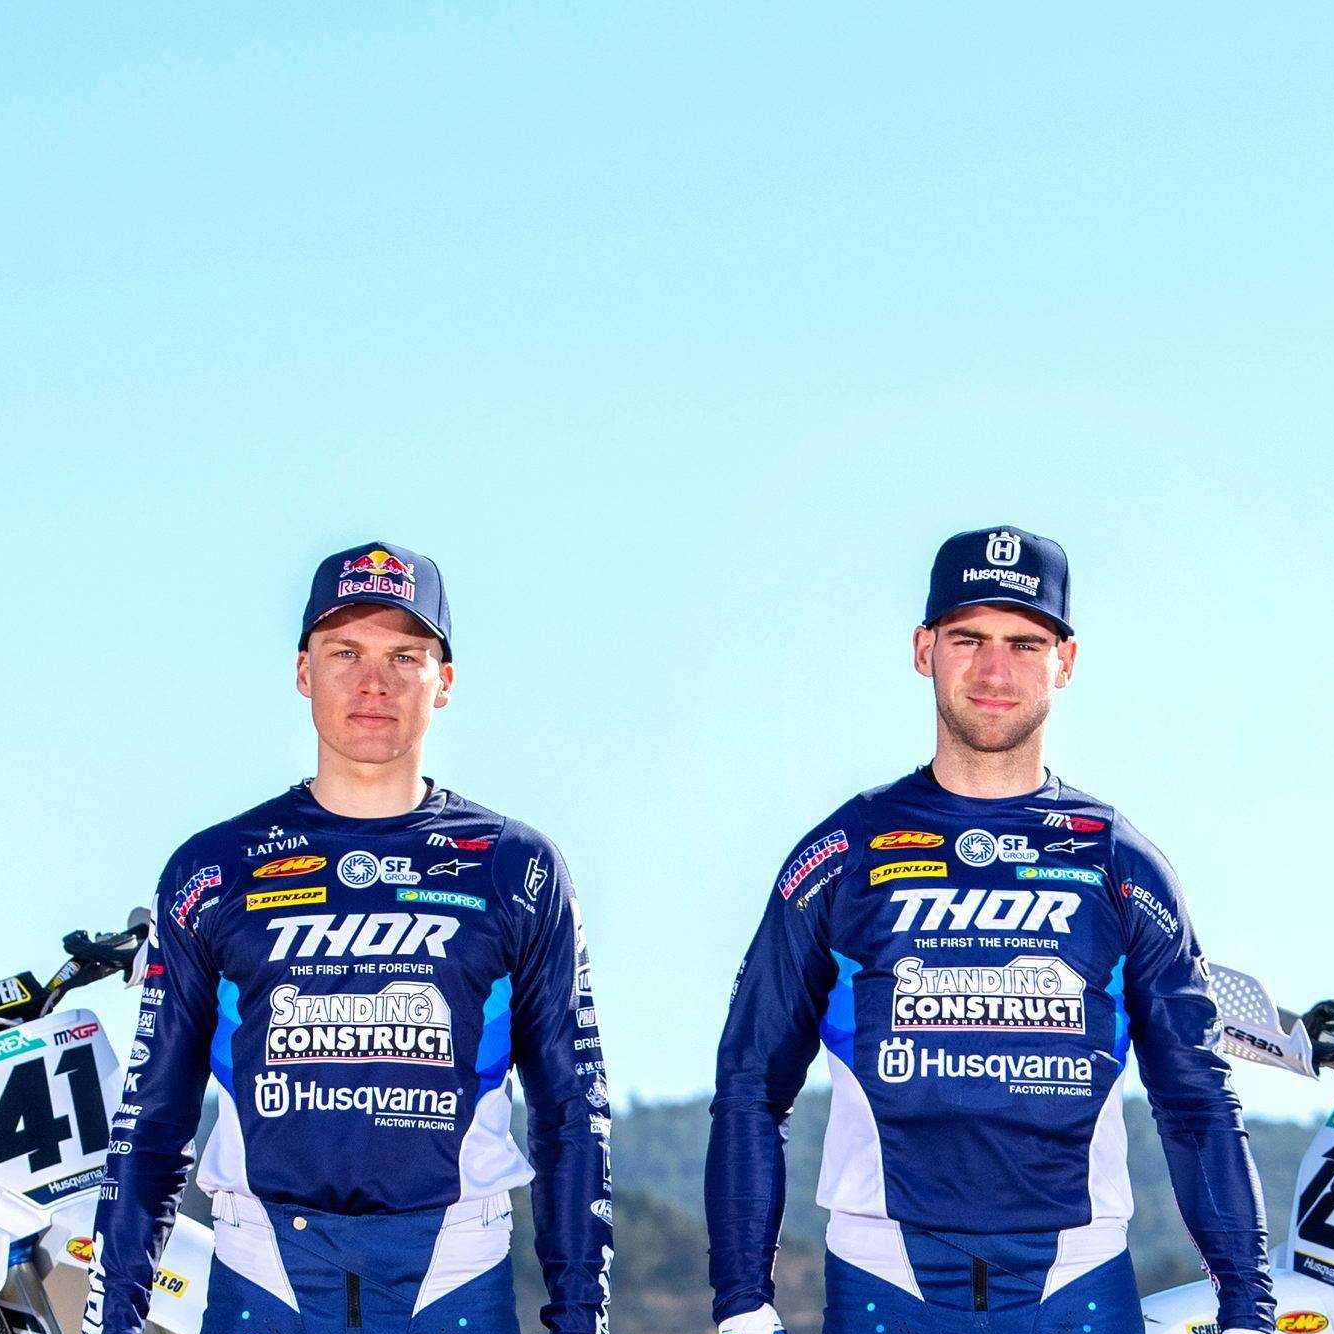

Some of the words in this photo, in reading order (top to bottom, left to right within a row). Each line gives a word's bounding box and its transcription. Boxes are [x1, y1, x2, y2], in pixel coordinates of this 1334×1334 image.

[338, 575, 376, 597] Red
[377, 577, 415, 602] Bull
[963, 568, 1038, 589] Husqvarna
[247, 835, 308, 856] LATVIJA
[870, 832, 944, 849] FMF
[1003, 838, 1023, 850] SF
[253, 856, 327, 877] FMF
[385, 860, 408, 872] SF
[778, 830, 846, 890] PARTS
[1003, 852, 1035, 860] GROUP
[385, 874, 417, 882] GROUP
[783, 840, 849, 900] EUROPE
[882, 866, 943, 876] DUNLOP
[1039, 869, 1101, 884] MOTOREX
[260, 891, 323, 904] DUNLOP
[420, 892, 481, 907] MOTOREX
[890, 889, 1081, 933] THOR
[267, 913, 460, 961] THOR
[914, 939, 937, 948] THE
[941, 938, 974, 948] FIRST
[978, 937, 1001, 947] THE
[1004, 938, 1058, 949] FOREVER
[290, 966, 313, 975] THE
[316, 965, 349, 974] FIRST
[353, 964, 376, 973] THE
[379, 963, 433, 974] FOREVER
[896, 959, 1061, 995] STANDING
[271, 984, 433, 1025] STANDING
[896, 996, 1082, 1021] CONSTRUCT
[54, 1023, 98, 1046] MXGP
[269, 1026, 451, 1054] CONSTRUCT
[574, 1038, 601, 1051] BRIS
[1224, 1026, 1284, 1057] CERBIS
[921, 1049, 1092, 1082] Husqvarna
[295, 1081, 457, 1114] Husqvarna
[1010, 1085, 1055, 1095] FACTORY
[1058, 1087, 1091, 1096] RACING
[375, 1118, 415, 1129] FACTORY
[418, 1120, 454, 1130] RACING
[49, 1168, 103, 1194] Husqvarna
[167, 1277, 183, 1292] CO
[1276, 1313, 1327, 1334] FMF
